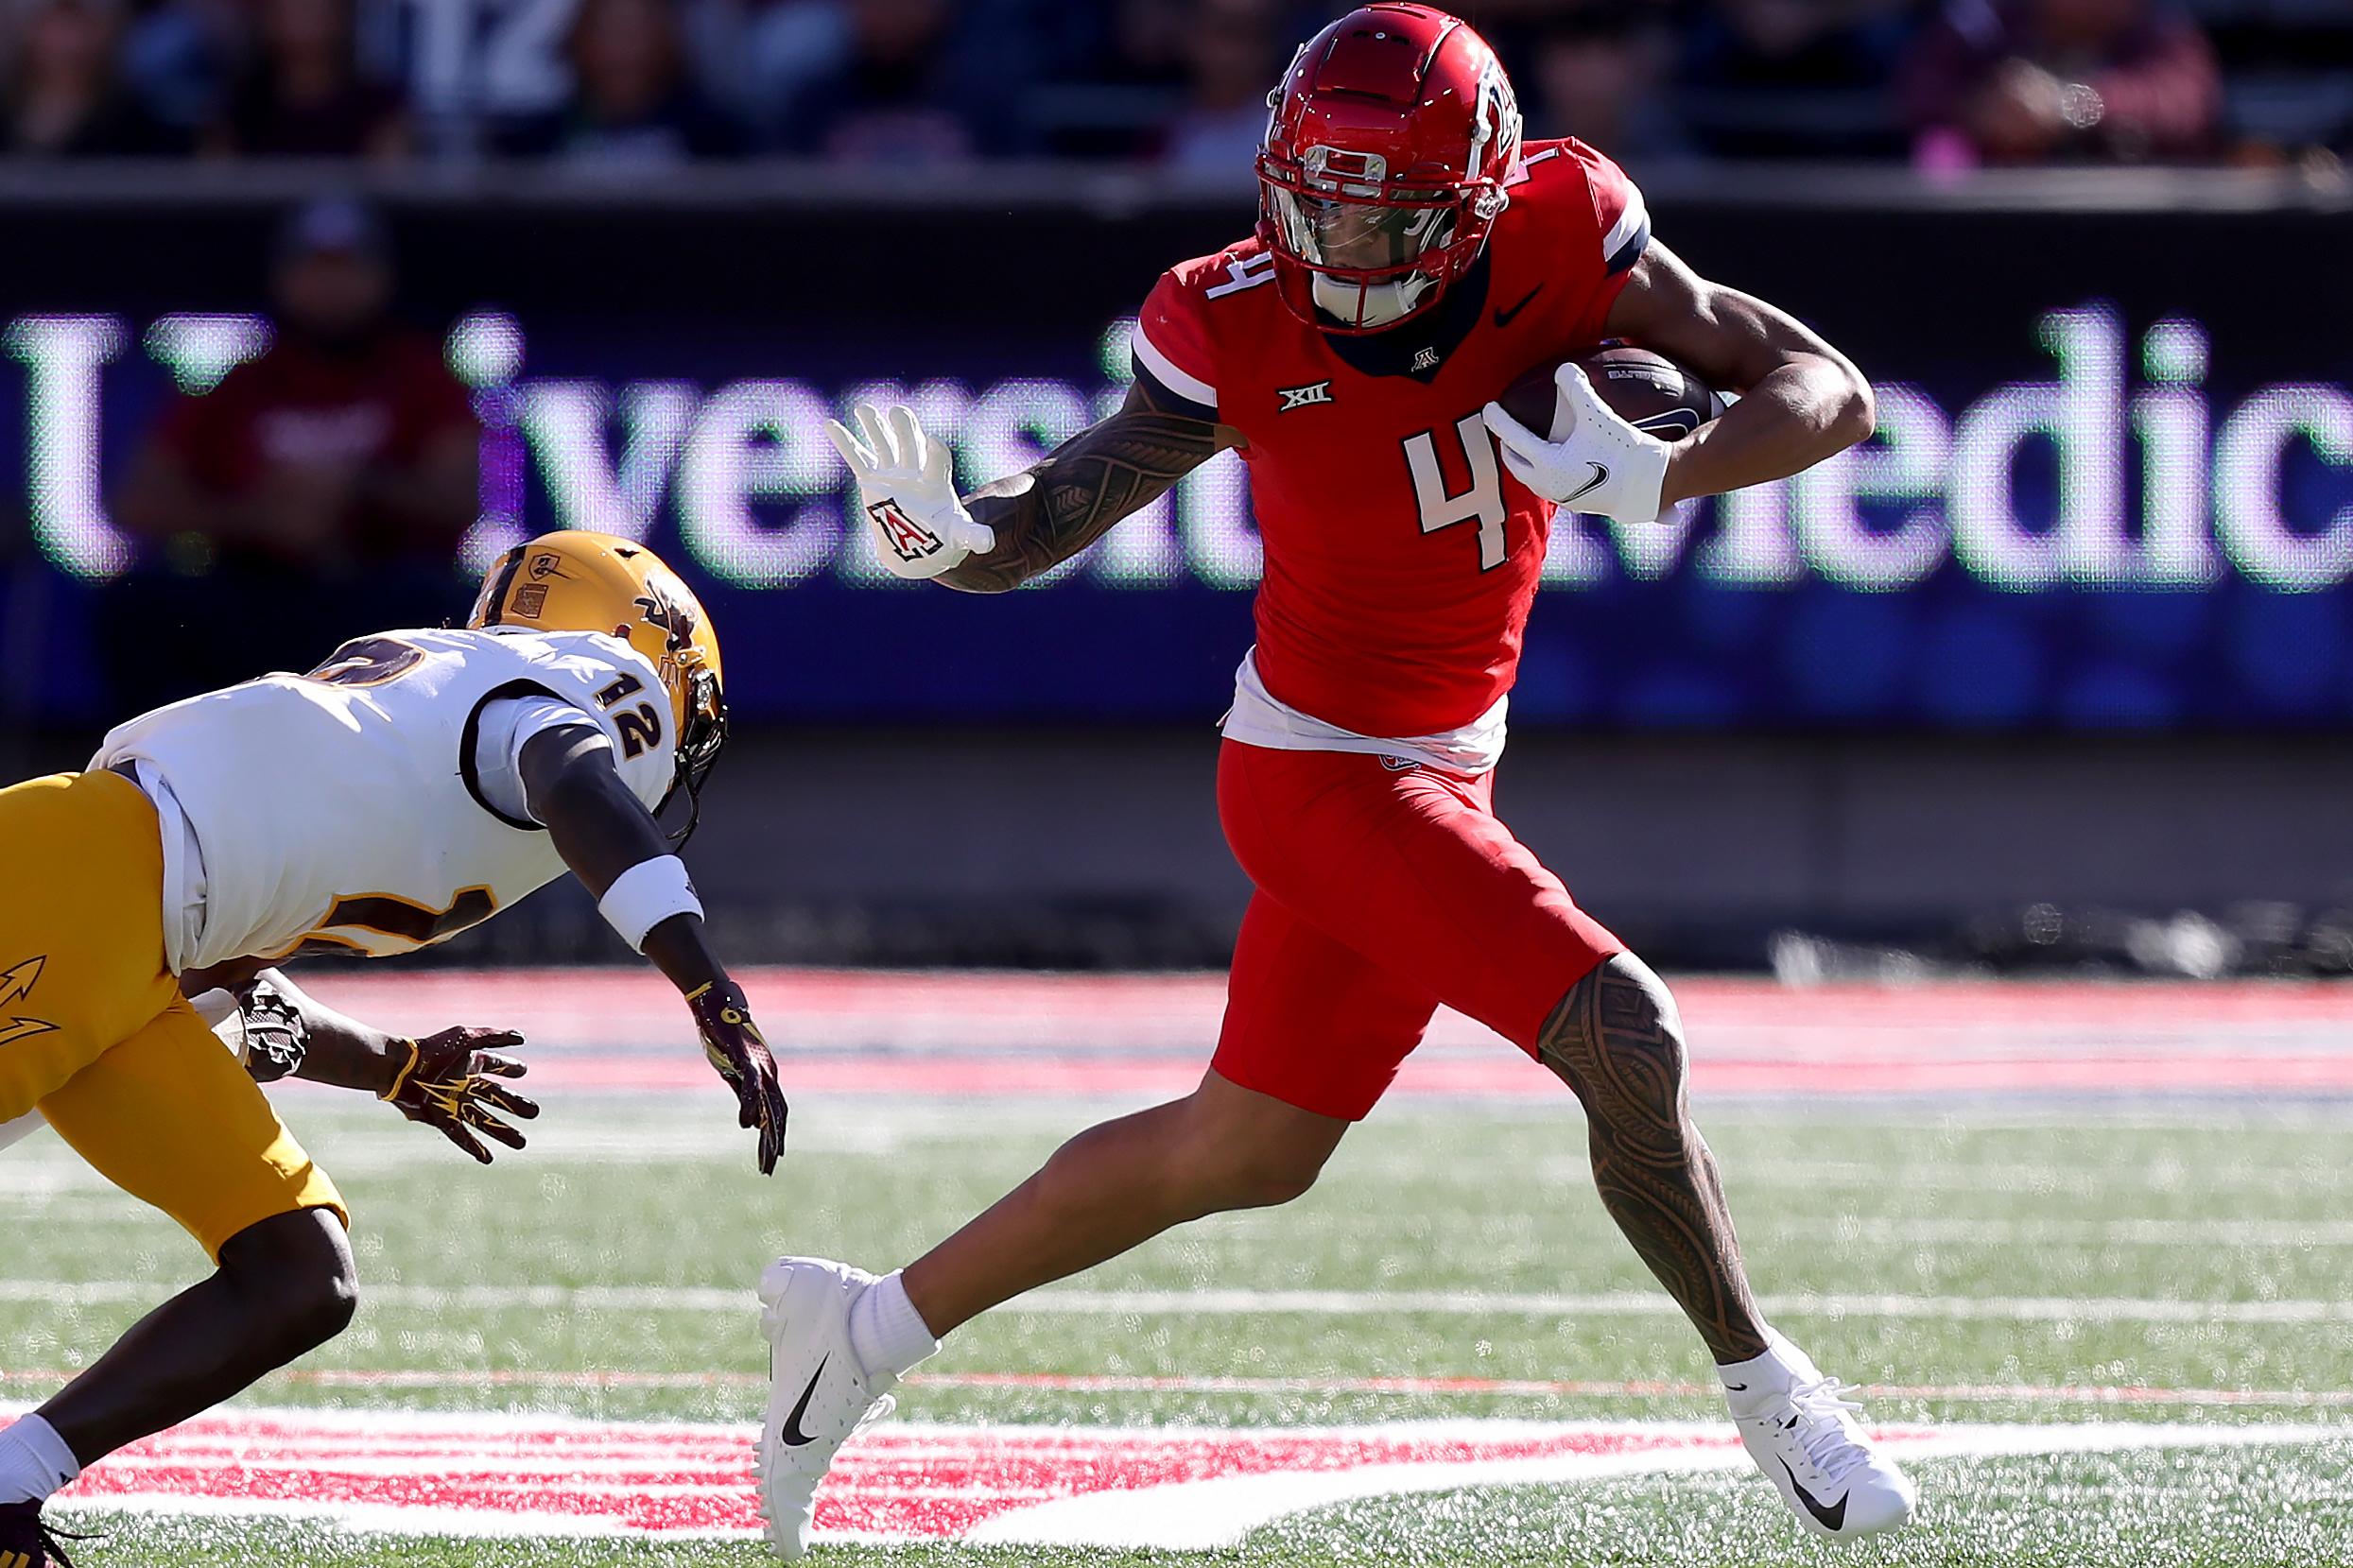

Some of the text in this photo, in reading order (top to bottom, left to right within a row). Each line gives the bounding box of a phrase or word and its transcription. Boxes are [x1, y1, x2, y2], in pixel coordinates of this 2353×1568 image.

[1277, 380, 1333, 412] XII
[866, 496, 943, 562] A
[1401, 410, 1507, 571] 4
[591, 670, 662, 763] 12
